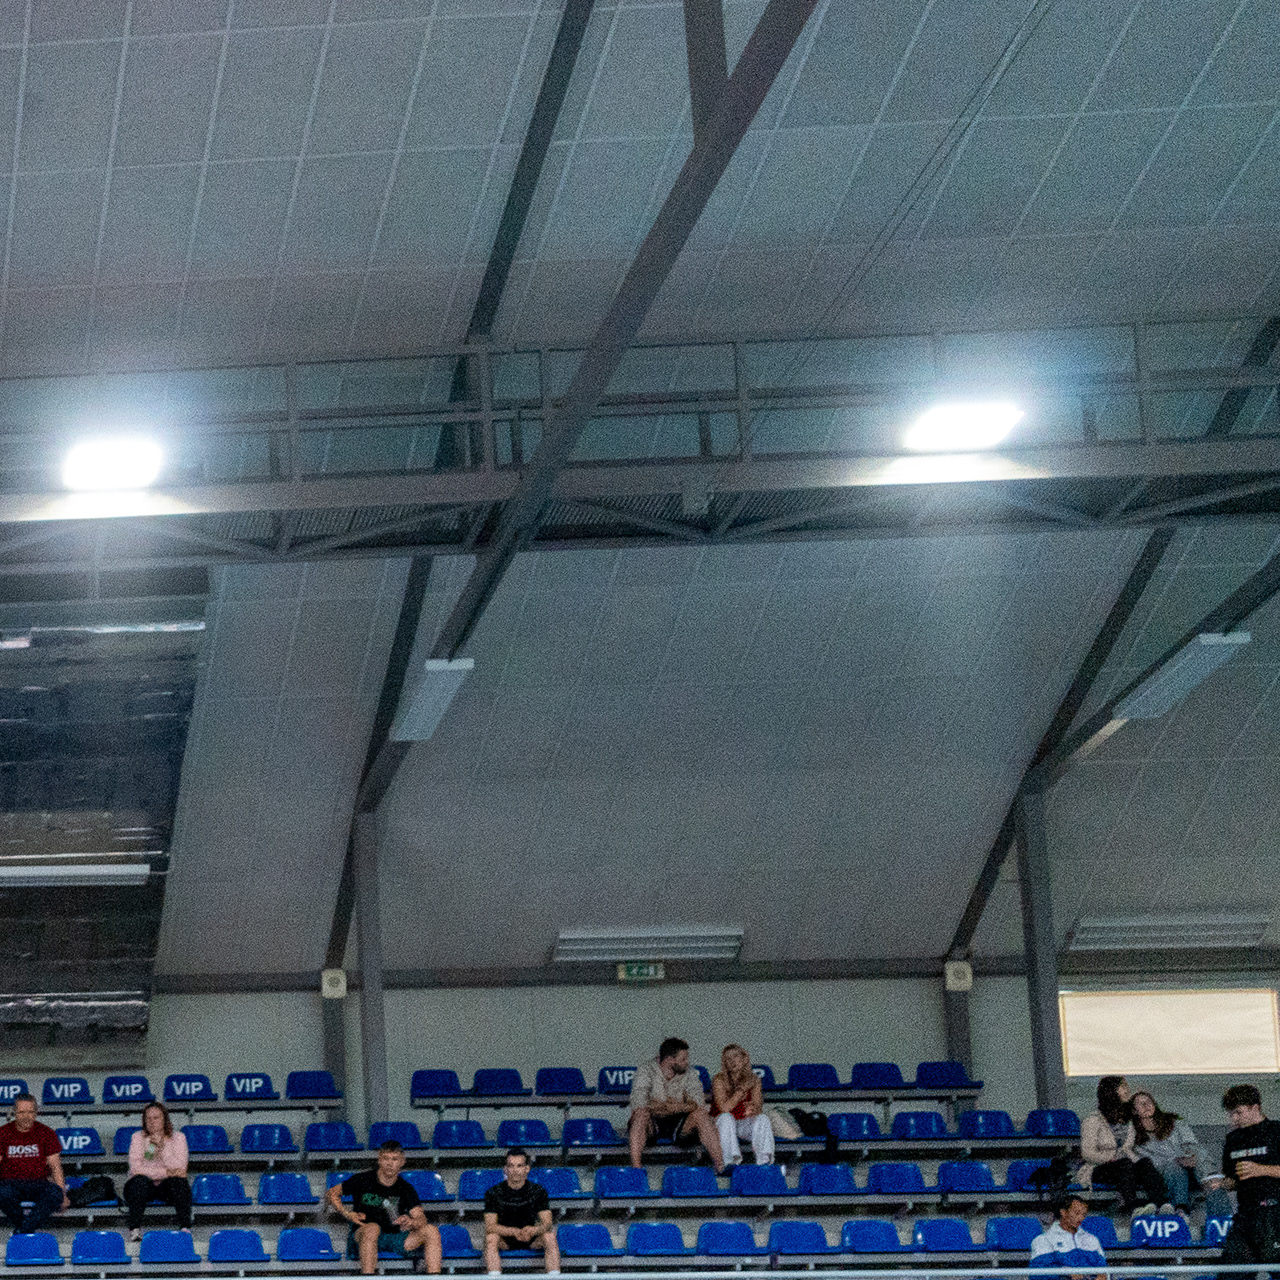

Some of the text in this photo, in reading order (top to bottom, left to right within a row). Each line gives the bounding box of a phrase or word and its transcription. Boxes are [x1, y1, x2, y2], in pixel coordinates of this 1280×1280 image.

[51, 1083, 81, 1099] VIP
[112, 1084, 143, 1098] VIP
[172, 1081, 203, 1095] VIP
[232, 1077, 263, 1093] VIP
[8, 1143, 39, 1155] BOSS
[59, 1135, 91, 1150] VIP
[1140, 1220, 1180, 1238] VIP
